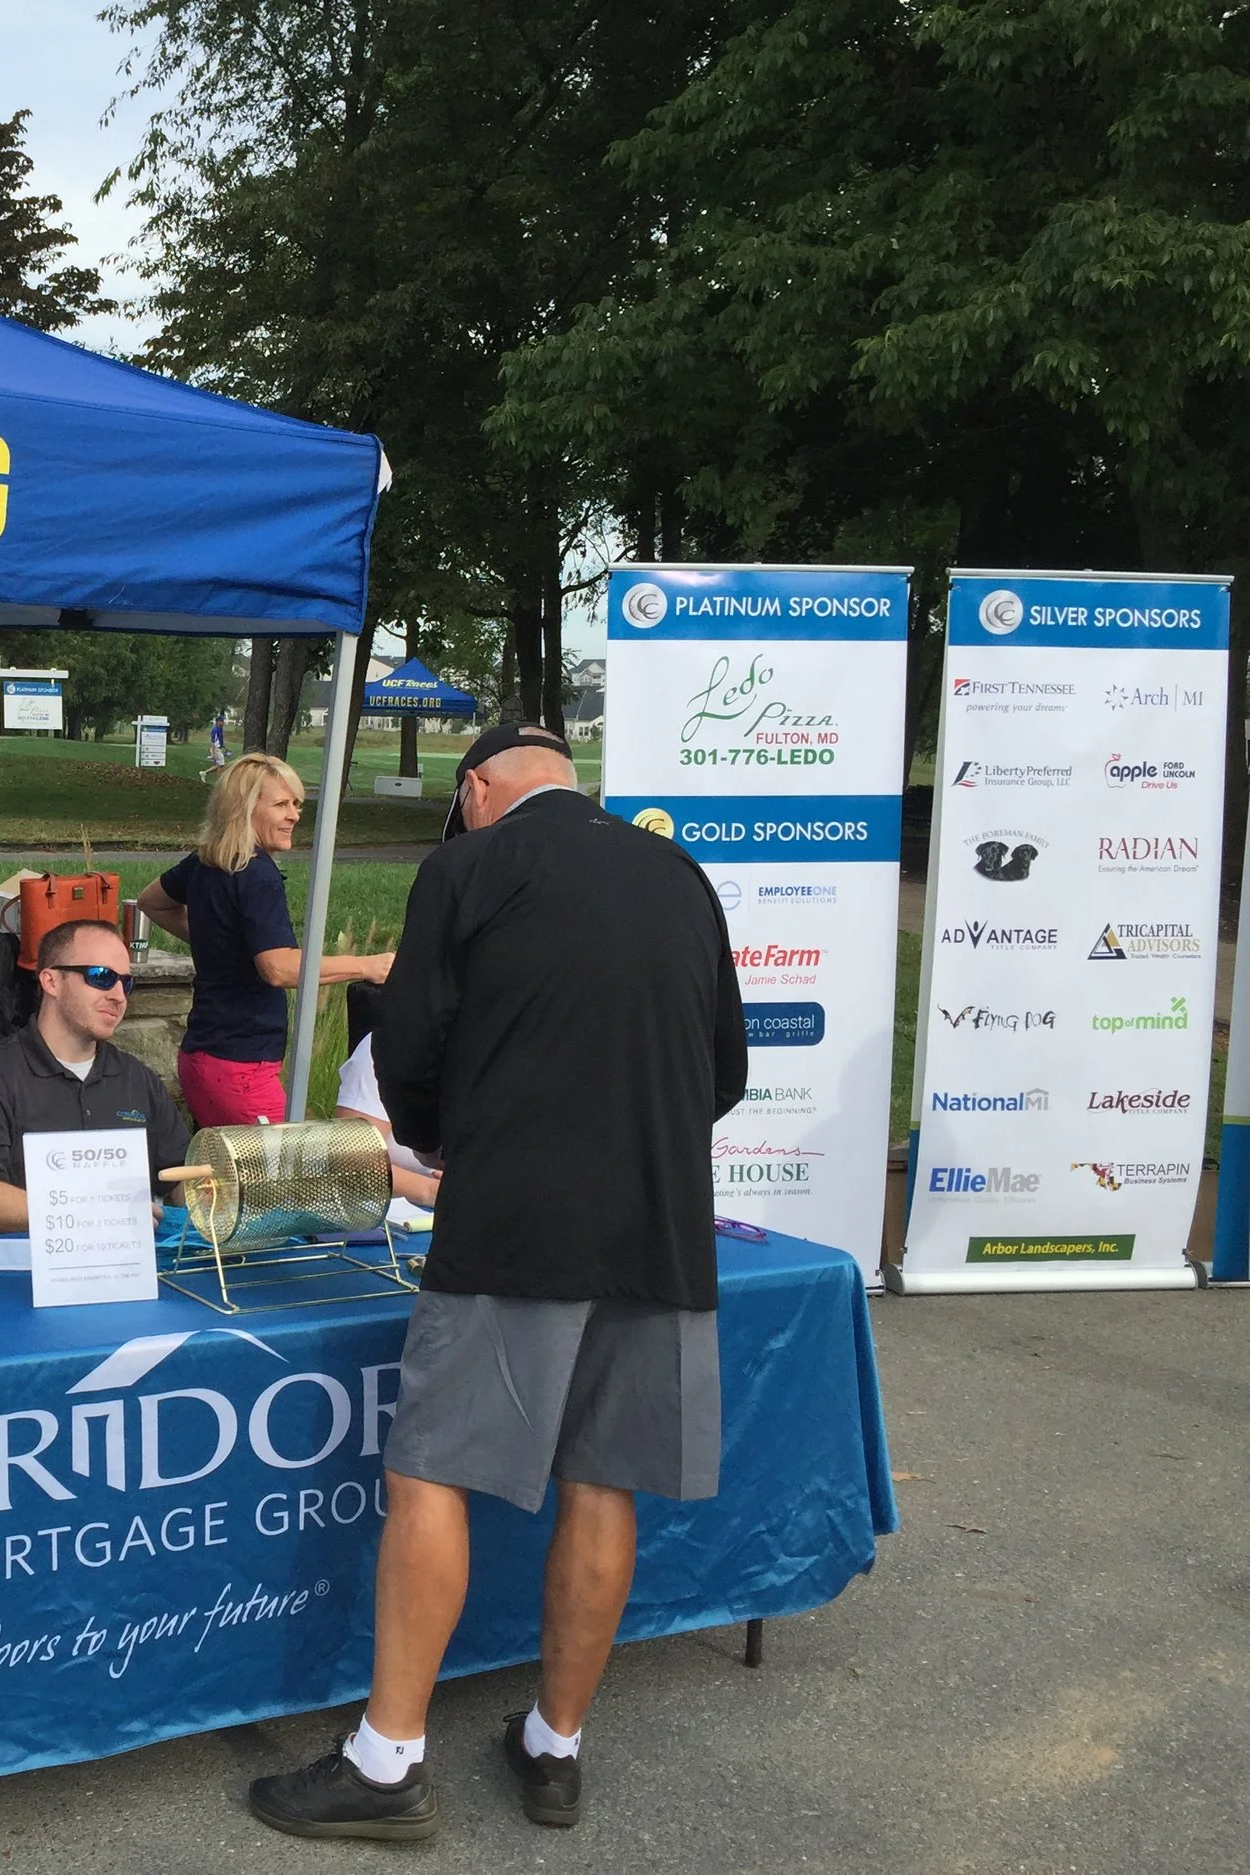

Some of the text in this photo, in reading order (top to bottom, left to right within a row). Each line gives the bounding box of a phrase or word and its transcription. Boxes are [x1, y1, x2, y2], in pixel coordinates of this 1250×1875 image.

[675, 597, 891, 618] PLATINUM SPONSOR
[1029, 605, 1201, 629] SILVER SPONSORS
[381, 679, 405, 687] UCF
[972, 681, 1075, 695] FIRST TENNESSEE
[369, 695, 442, 708] UCFRACES.ORG
[681, 654, 774, 743] Ledo
[1130, 686, 1204, 706] Arch MI
[965, 702, 1010, 713] powering
[1012, 703, 1032, 714] your
[755, 732, 839, 746] FULTON, MD
[679, 748, 835, 766] 301-776-LEDO
[1110, 761, 1158, 782] apple
[1163, 761, 1185, 769] FORD
[985, 777, 1026, 786] Insurance
[1056, 777, 1071, 786] LLC
[1163, 770, 1196, 778] LINCOLN
[1141, 781, 1178, 789] Drive Us
[681, 821, 868, 842] GOLD SPONSORS
[963, 829, 1050, 849] THE FOREMAN FAMILY
[1098, 837, 1198, 860] RADIAN
[1098, 864, 1126, 874] Ensuring
[1127, 864, 1138, 872] the
[1139, 864, 1171, 872] American
[758, 886, 837, 896] EMPLOYEEONE
[941, 920, 1058, 949] ADVANTAGE
[1117, 924, 1193, 938] TRICAPITAL
[1127, 938, 1200, 952] ADVISORS
[745, 973, 816, 985] Jamie Schad
[763, 1014, 815, 1030] coastal
[775, 1088, 813, 1101] BANK
[1087, 1089, 1191, 1114] Lakeside
[71, 1147, 128, 1162] 50/50
[711, 1136, 825, 1159] Gardens
[73, 1160, 127, 1168] RAFFLE
[1117, 1163, 1191, 1177] TERRAPIN
[728, 1162, 810, 1183] HOUSE
[1124, 1176, 1187, 1185] Business Systems
[49, 1190, 69, 1206] $5
[743, 1188, 771, 1198] always
[773, 1187, 782, 1196] in
[45, 1214, 75, 1231] $10
[45, 1237, 74, 1254] $20
[982, 1239, 1119, 1256] Arbor Landscapers, Inc.
[255, 1477, 388, 1536] GROU
[71, 1616, 107, 1657] to
[109, 1605, 196, 1679] your
